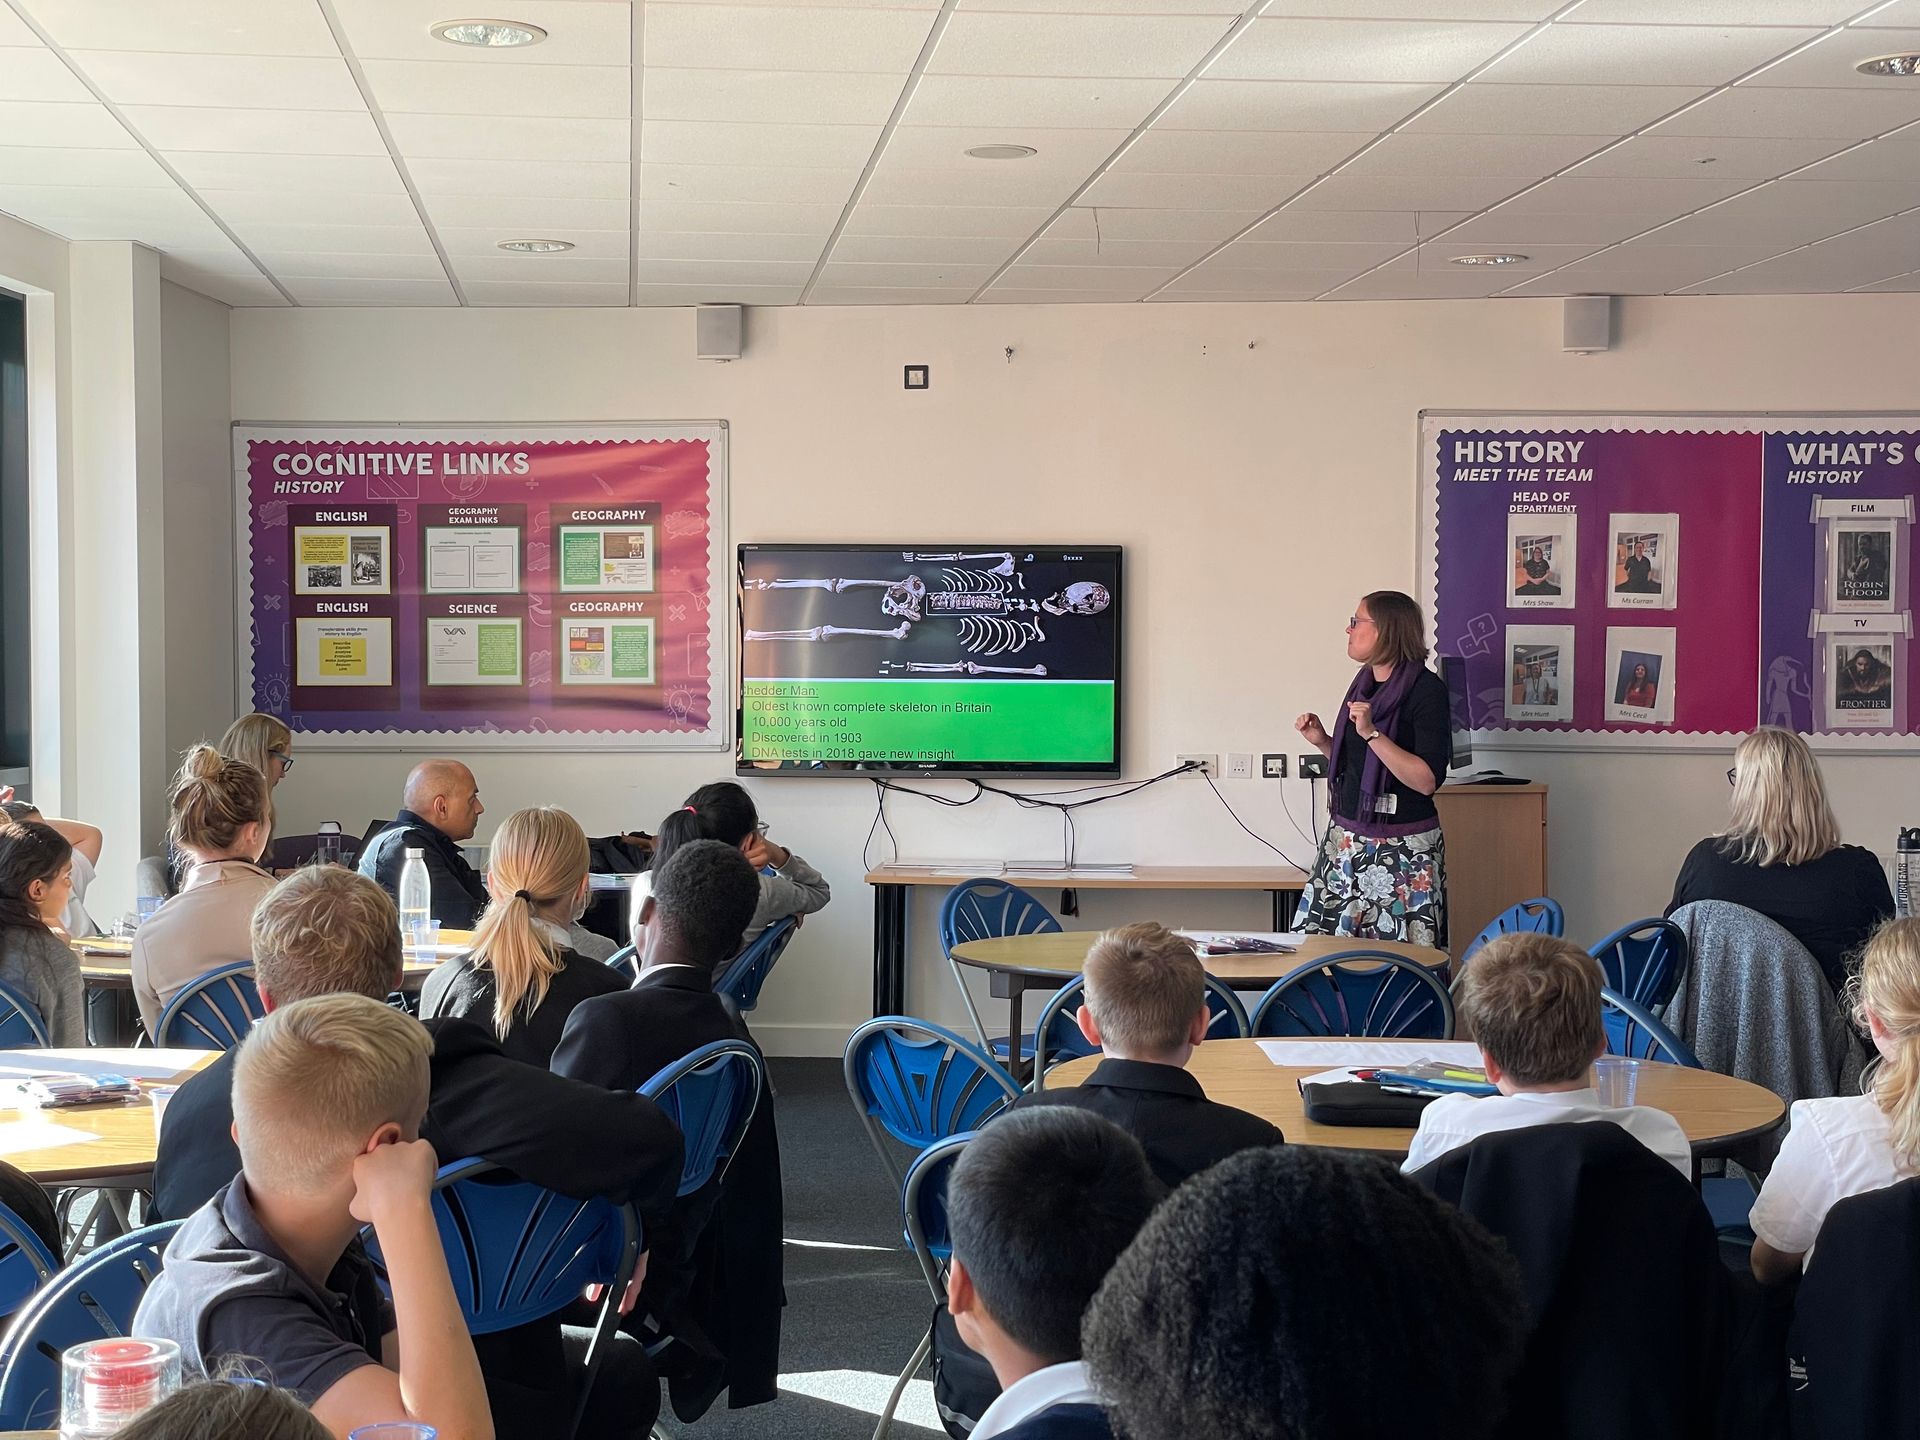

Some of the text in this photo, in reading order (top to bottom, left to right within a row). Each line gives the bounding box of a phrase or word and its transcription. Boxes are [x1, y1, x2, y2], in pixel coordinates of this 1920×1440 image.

[1455, 441, 1584, 463] HISTORY
[1786, 442, 1904, 465] WHAT'S
[272, 452, 530, 475] COGNITIVE LINKS
[1453, 468, 1593, 482] MEET THE TEAM
[1787, 470, 1863, 484] HISTORY
[273, 481, 344, 494] HISTORY
[1513, 492, 1571, 502] HEAD OF
[448, 507, 499, 515] GEOGRAPHY
[1509, 504, 1577, 513] DEPARTMENT
[1851, 504, 1875, 512] FILM
[315, 511, 368, 522] ENGLISH
[448, 516, 499, 524] EXAM LINKS
[571, 510, 646, 520] GEOGRAPHY
[1844, 580, 1884, 589] ROBIN
[316, 602, 369, 613] ENGLISH
[448, 604, 498, 614] SCIENCE
[569, 602, 644, 612] GEOGRAPHY
[1854, 619, 1867, 627] TV
[790, 685, 819, 696] Man:
[752, 701, 992, 714] Oldest known complete skeleton in Britain
[1840, 700, 1887, 708] FRONTIER
[753, 716, 847, 730] 10,000 years old
[752, 732, 862, 743] Discovered in 1903
[752, 747, 955, 761] DNA tests in 2018 gave new insight
